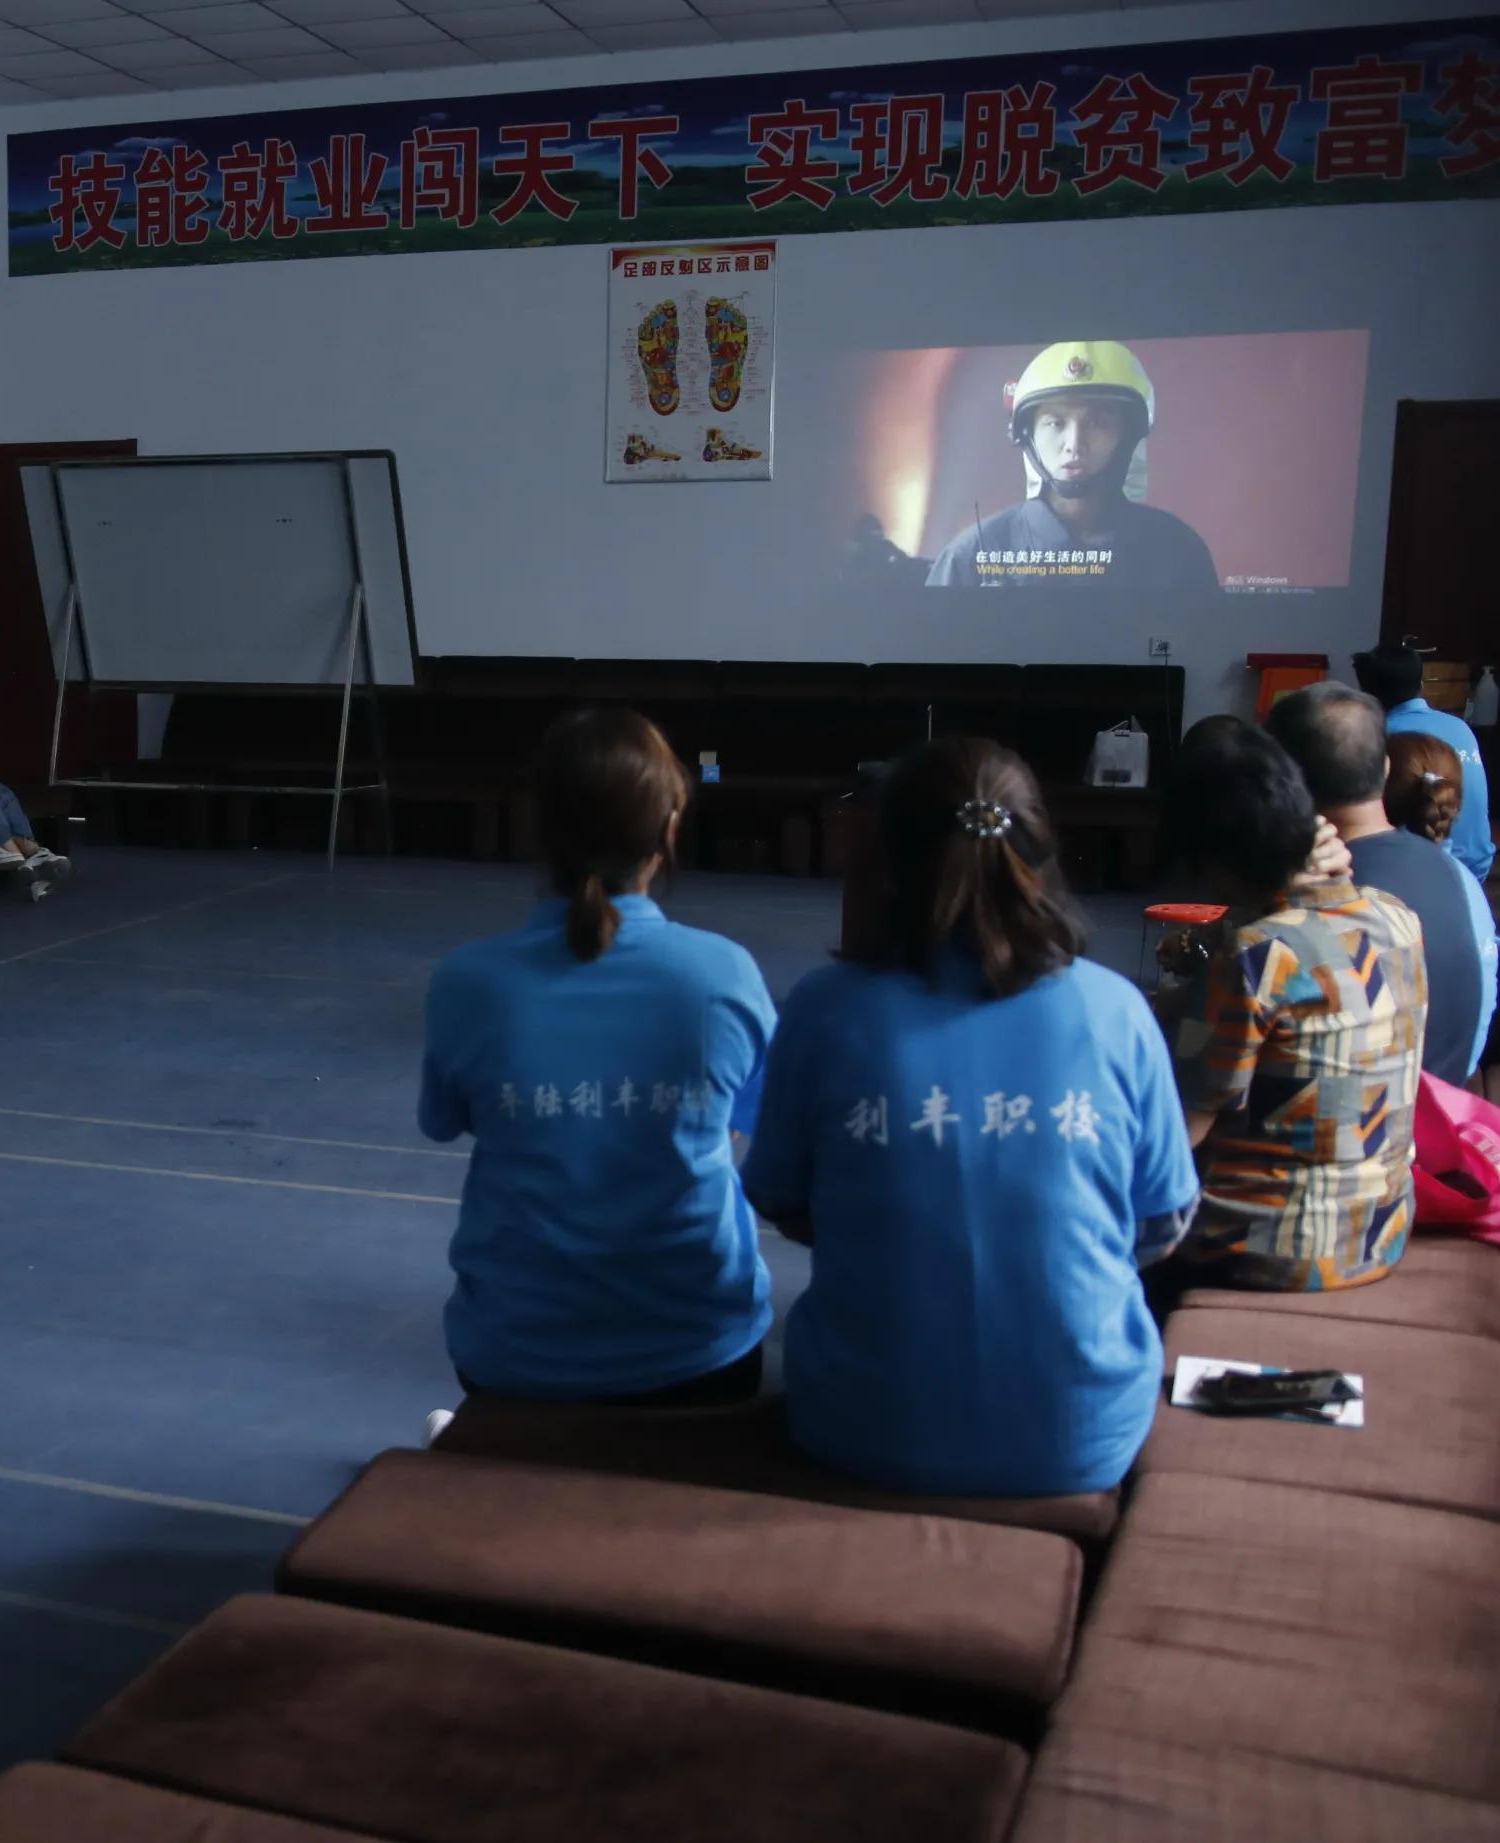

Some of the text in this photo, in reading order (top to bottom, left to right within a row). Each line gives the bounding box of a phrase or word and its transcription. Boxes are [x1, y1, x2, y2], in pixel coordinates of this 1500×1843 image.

[48, 51, 1500, 253] 技能就业闯天下 实现脱贫致富梦
[623, 254, 769, 278] 足部反射区示意图
[976, 550, 1112, 563] 在创造美好生活的同时
[977, 564, 1004, 574] While
[1007, 565, 1046, 576] creating
[1058, 565, 1087, 574] better
